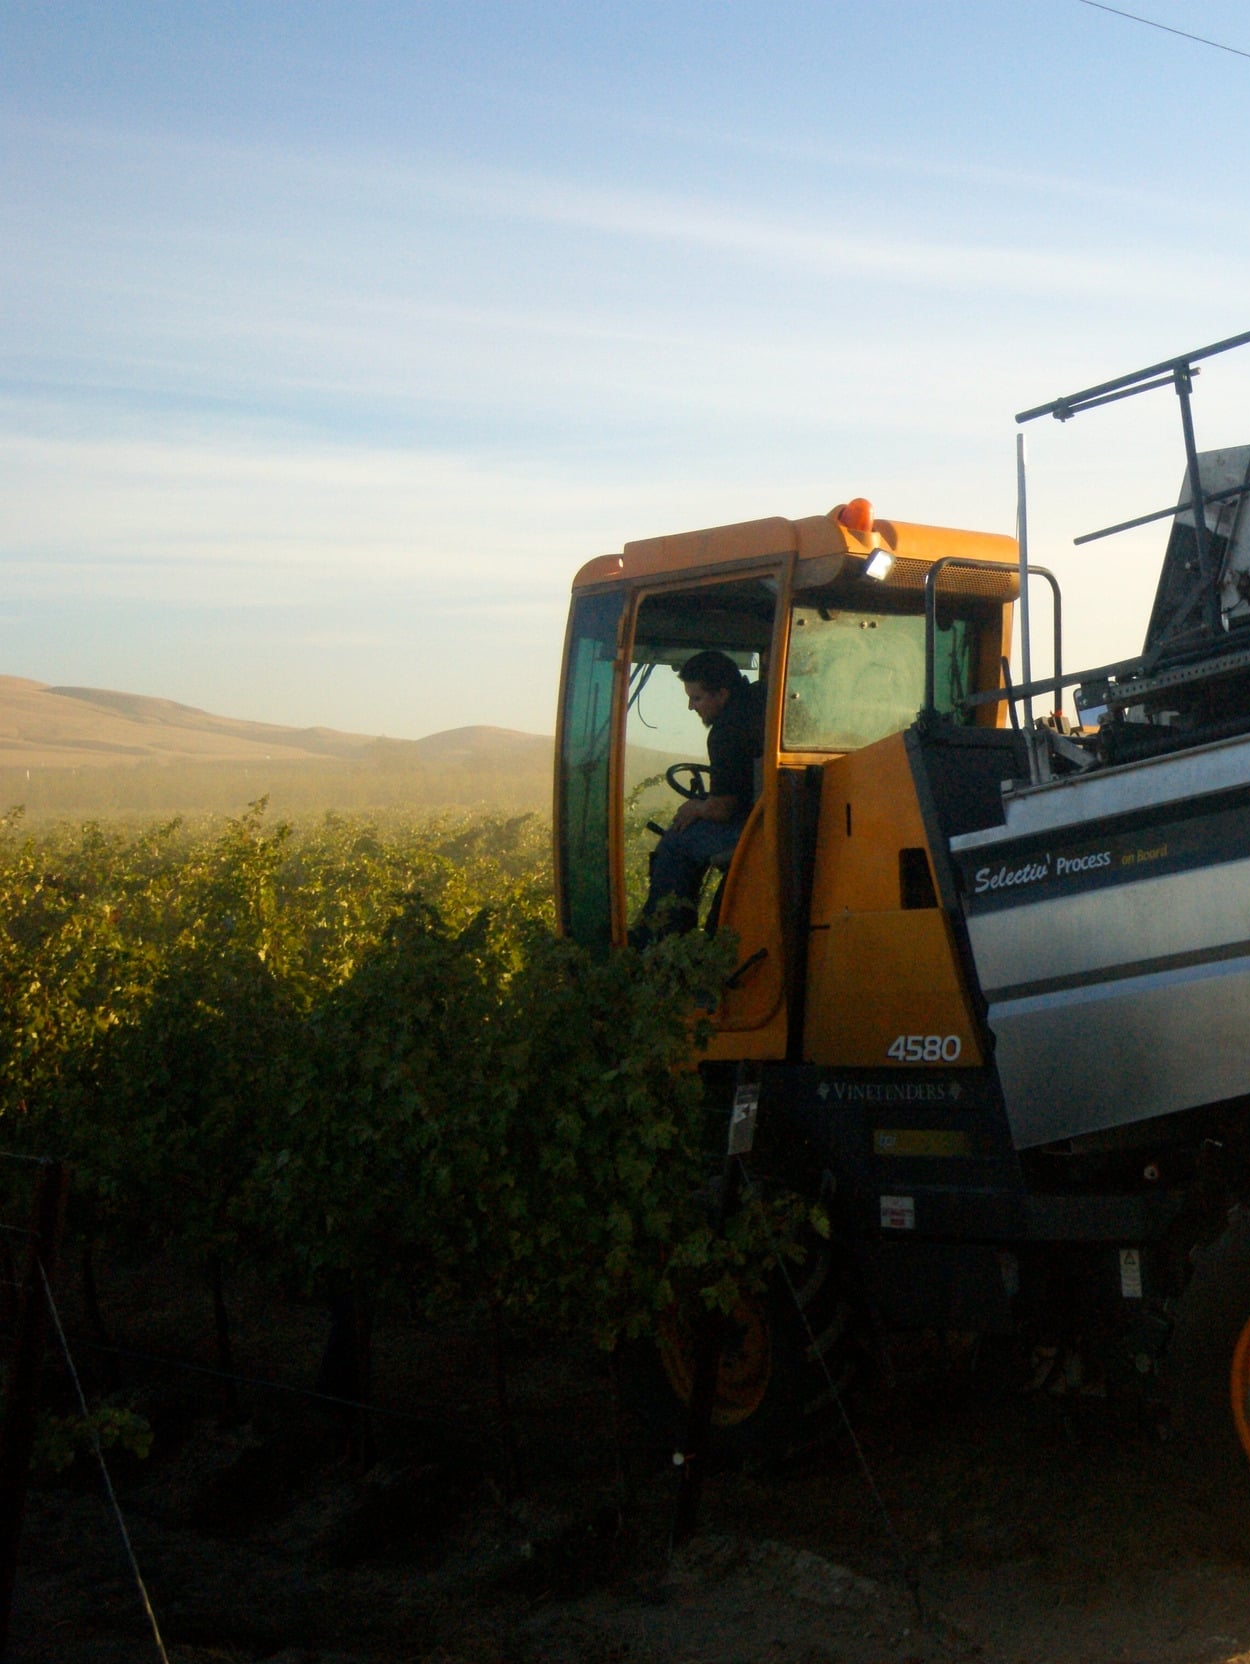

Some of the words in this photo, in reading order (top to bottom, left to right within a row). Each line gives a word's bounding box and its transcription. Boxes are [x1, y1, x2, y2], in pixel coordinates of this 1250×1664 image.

[1056, 851, 1112, 876] Process
[1121, 855, 1135, 865] on
[886, 1034, 962, 1062] 4580
